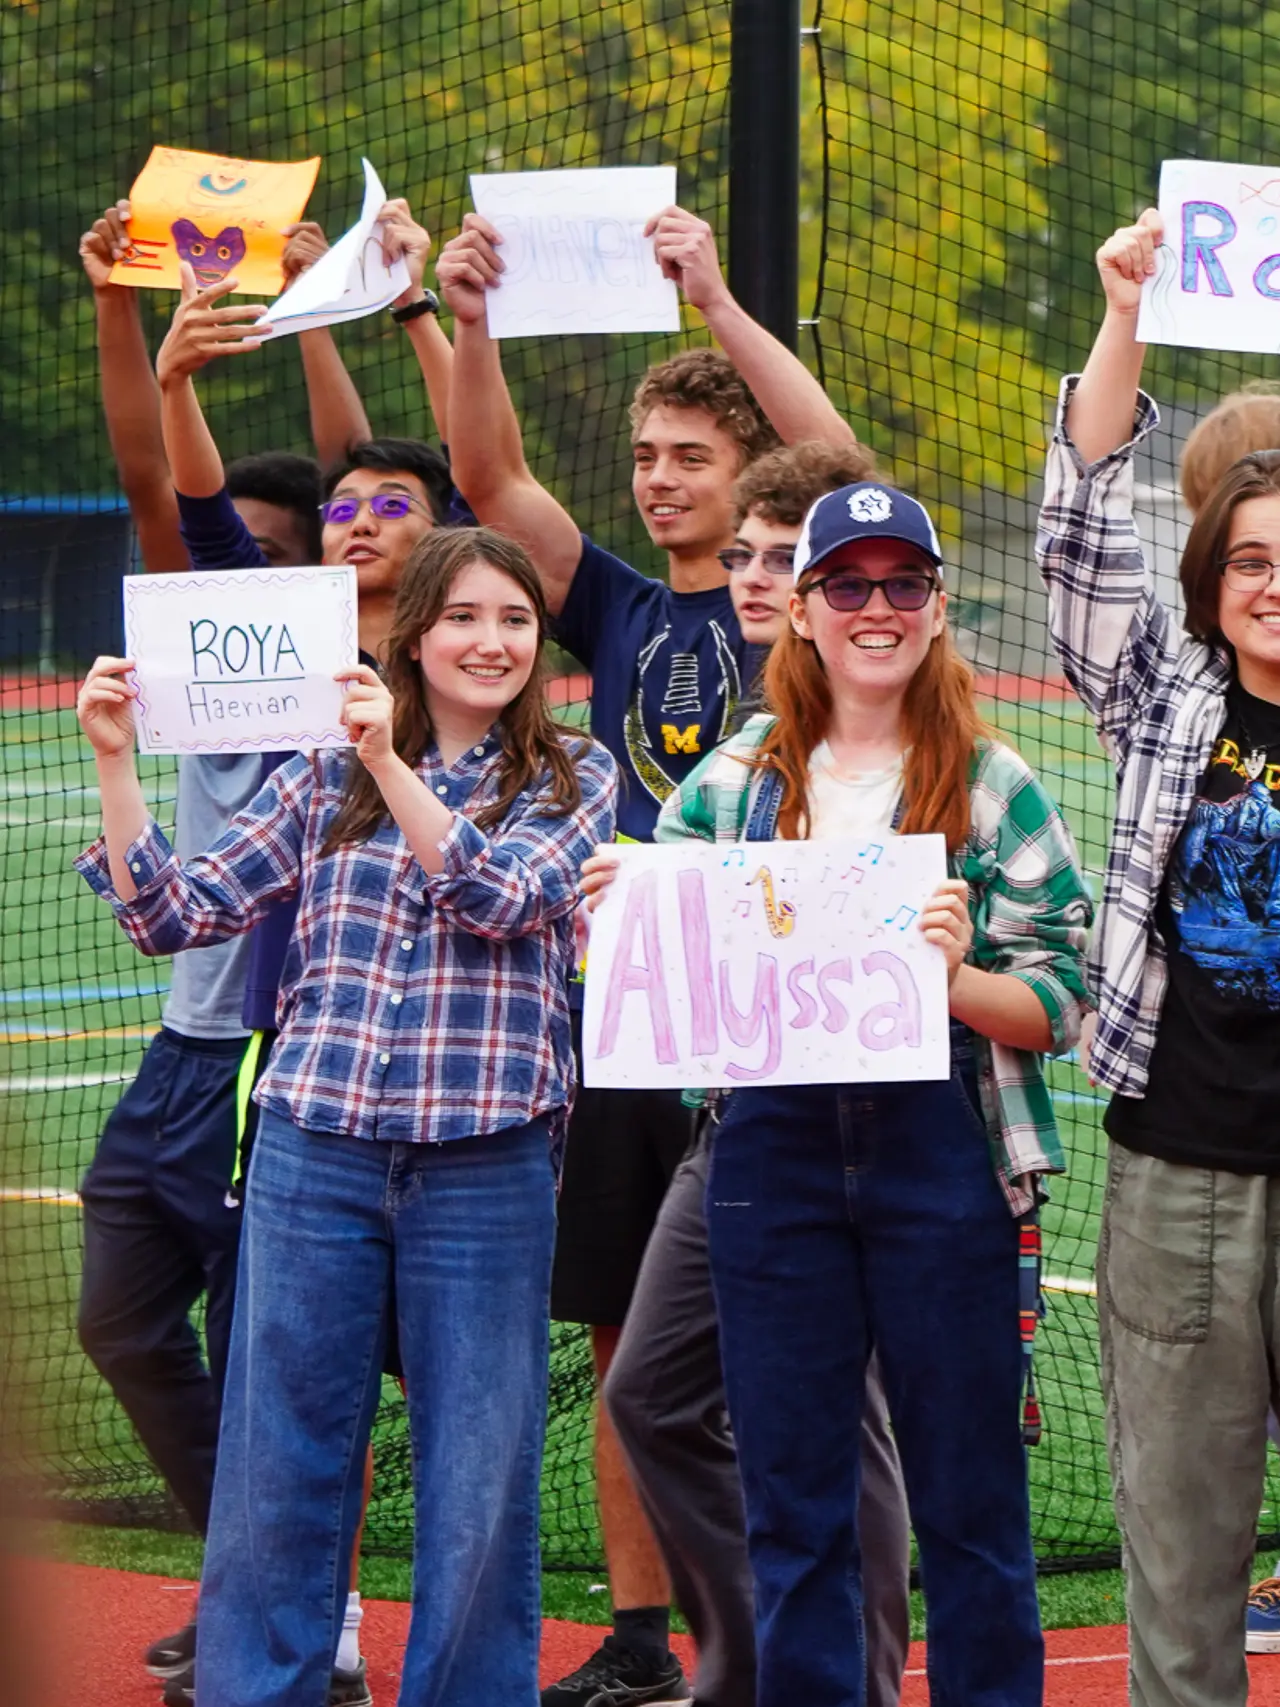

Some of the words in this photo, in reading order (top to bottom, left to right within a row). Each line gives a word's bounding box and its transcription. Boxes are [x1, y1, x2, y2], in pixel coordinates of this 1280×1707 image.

[189, 618, 304, 677] ROYA
[185, 684, 299, 726] Haerian
[660, 724, 701, 755] M
[594, 867, 922, 1081] Alyssa
